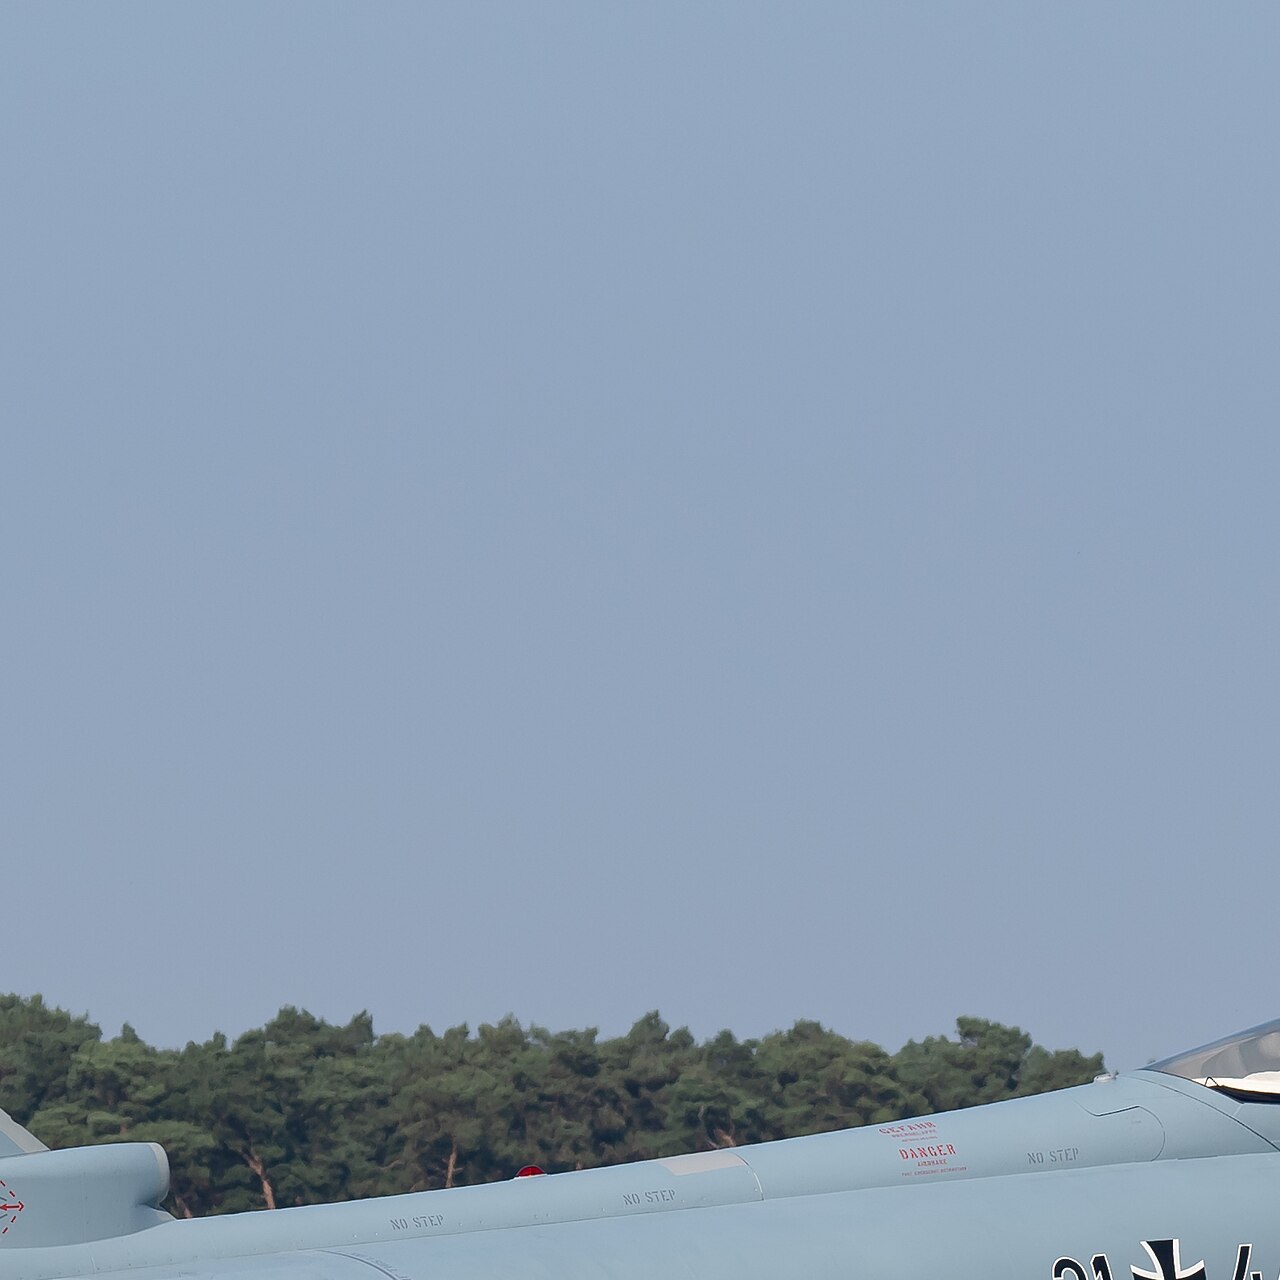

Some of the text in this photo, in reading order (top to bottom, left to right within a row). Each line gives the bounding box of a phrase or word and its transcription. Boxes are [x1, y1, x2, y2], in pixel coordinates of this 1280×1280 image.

[899, 1143, 957, 1160] DANGER
[1027, 1147, 1079, 1164] NO STEP
[622, 1189, 675, 1205] NO STEP
[390, 1214, 444, 1231] NO STEP
